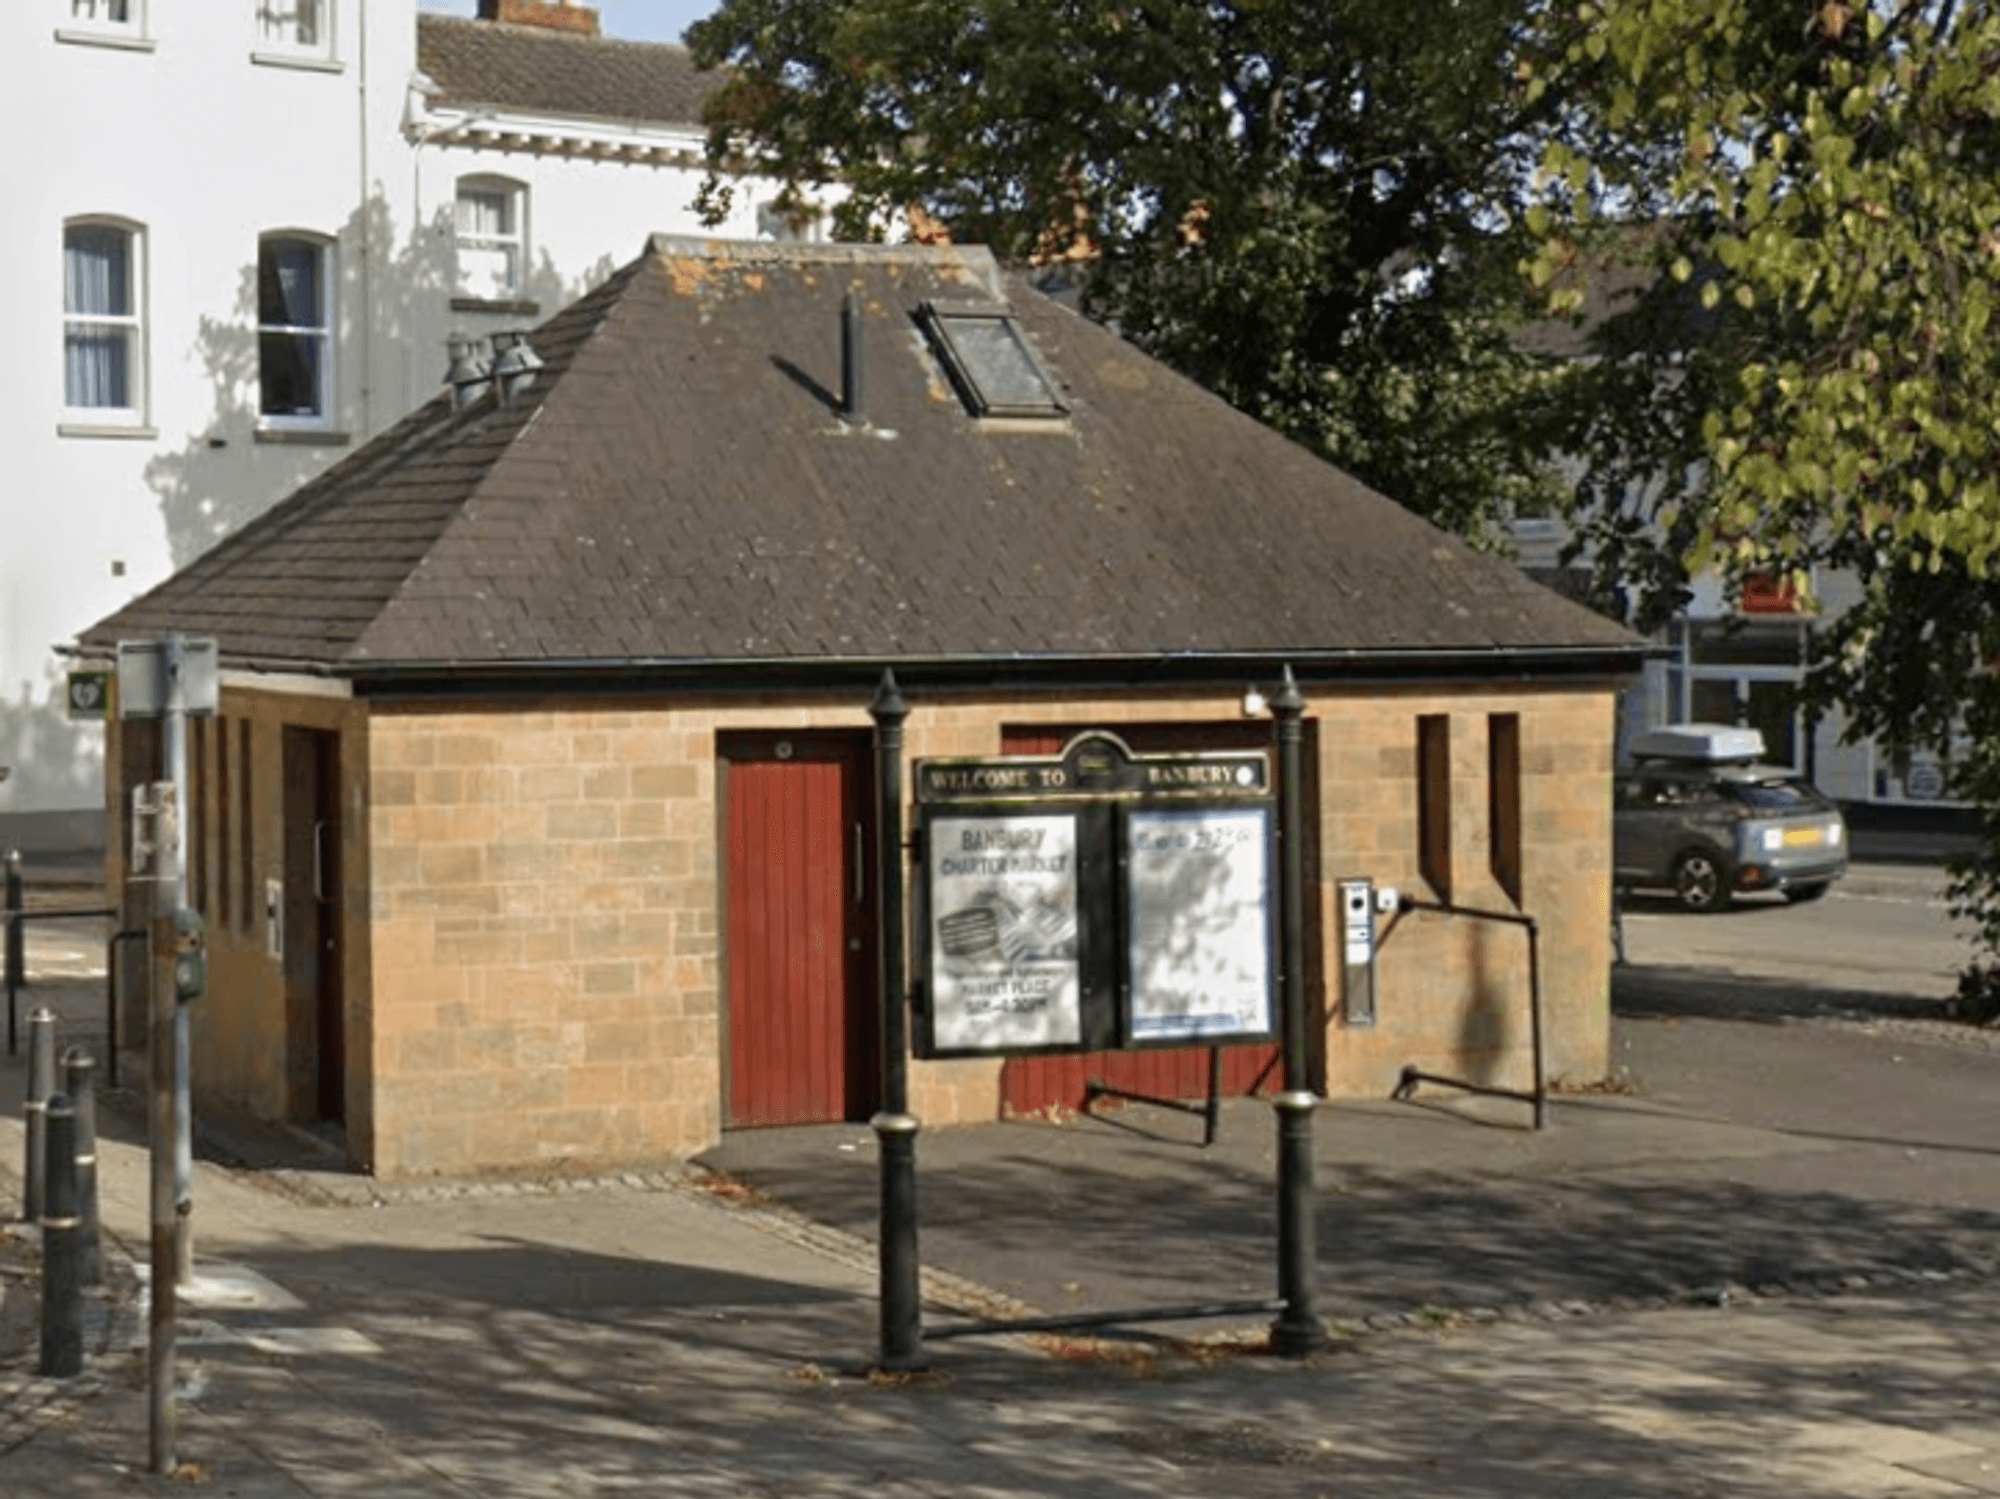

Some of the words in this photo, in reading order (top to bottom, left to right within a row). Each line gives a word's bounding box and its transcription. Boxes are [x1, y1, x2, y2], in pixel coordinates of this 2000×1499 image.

[931, 769, 1028, 788] WELCOME
[1040, 768, 1066, 787] TO
[1148, 766, 1234, 783] BANBURY
